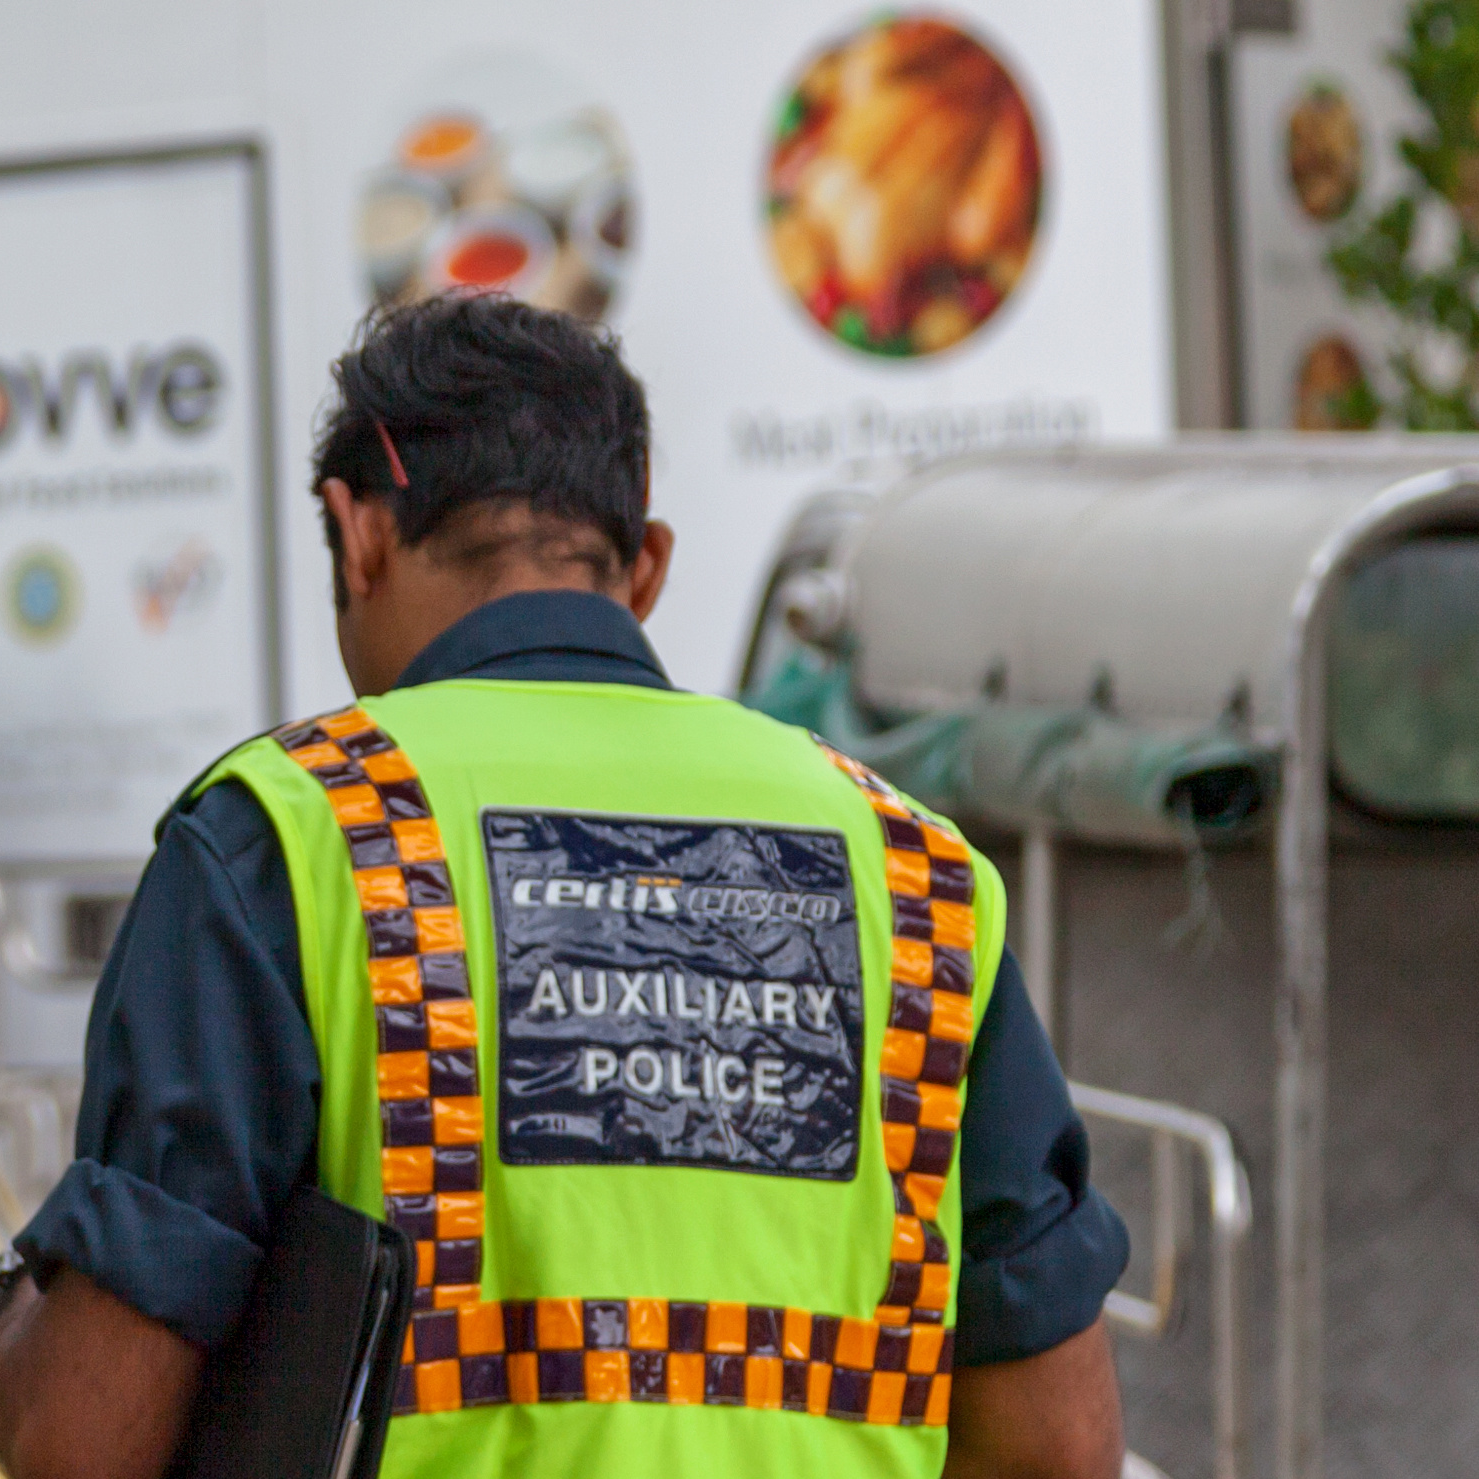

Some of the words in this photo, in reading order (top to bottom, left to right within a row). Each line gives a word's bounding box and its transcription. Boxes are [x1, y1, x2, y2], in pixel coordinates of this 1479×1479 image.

[512, 877, 682, 914] certis
[527, 968, 835, 1028] AUXILIARY
[583, 1048, 786, 1105] POLICE
